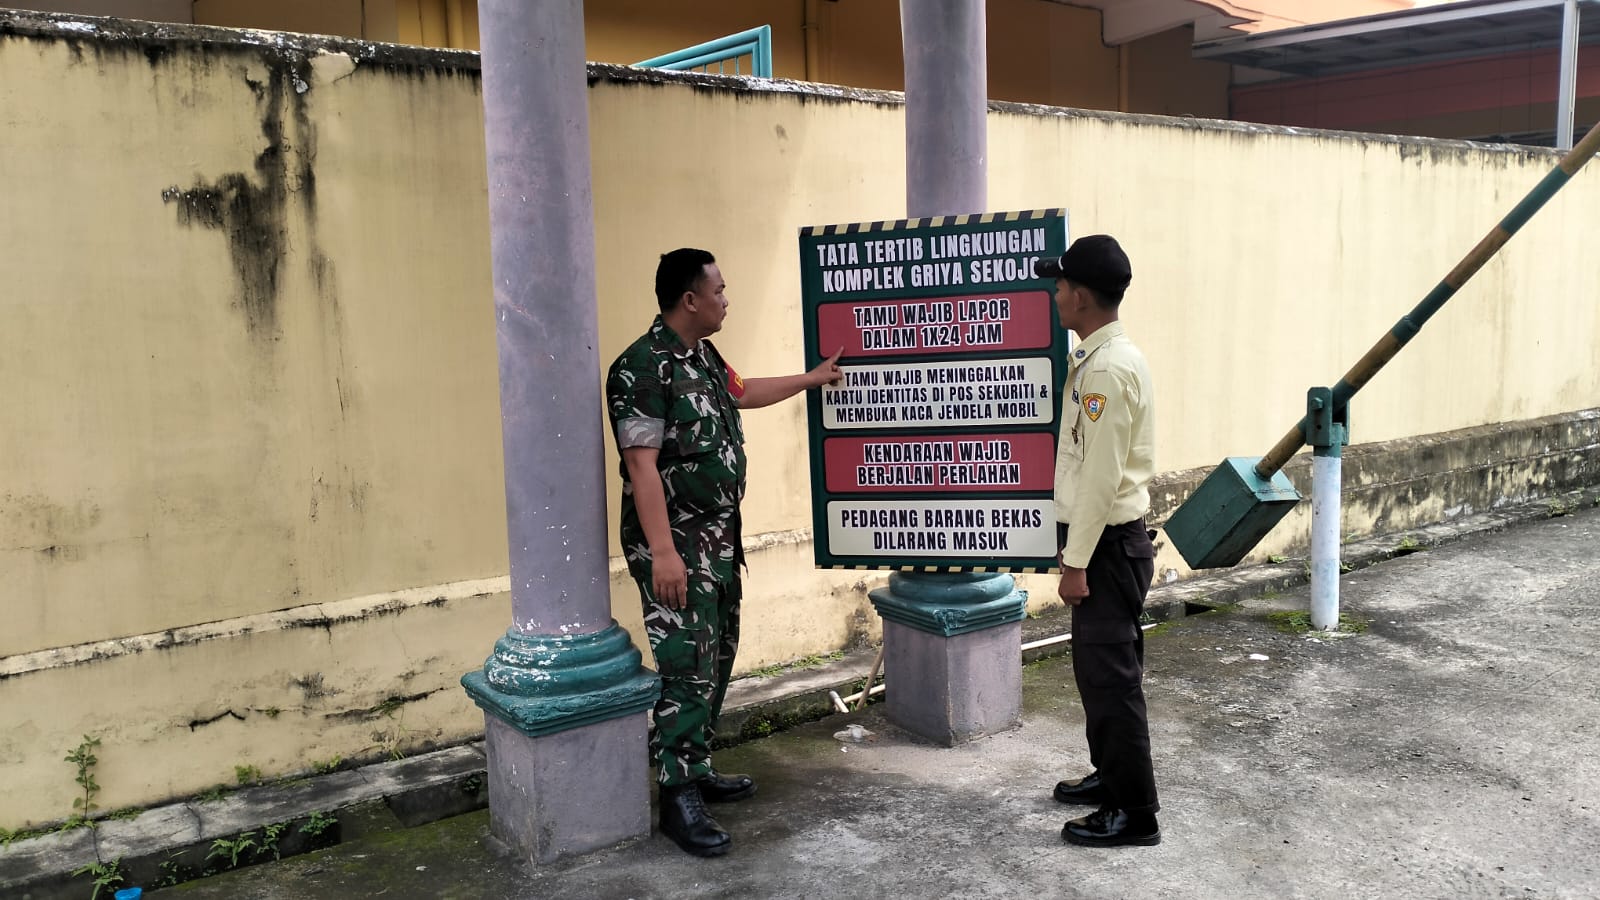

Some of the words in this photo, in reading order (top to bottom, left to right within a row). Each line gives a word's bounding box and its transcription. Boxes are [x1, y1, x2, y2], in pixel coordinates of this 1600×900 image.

[817, 243, 858, 266] TATA
[865, 237, 923, 263] TERTIB
[931, 228, 1045, 258] LINGKUNGAN
[823, 266, 904, 292] KOMPLEK
[911, 262, 963, 287] GRIYA
[855, 305, 897, 327] TAMU
[903, 302, 953, 325] WAJIB
[959, 299, 1010, 321] LAPOR
[863, 328, 915, 350] DALAM
[922, 326, 959, 346] 1X24
[966, 324, 1003, 345] JAM
[846, 370, 878, 386] TAMU
[883, 368, 922, 384] WAJIB
[927, 365, 1024, 383] MENINGGALKAN
[826, 390, 862, 405] KARTU
[868, 387, 927, 404] IDENTITAS
[933, 387, 944, 401] DI
[950, 386, 973, 401] POS
[979, 384, 1034, 400] SEKURITI
[1040, 384, 1048, 398] &
[836, 406, 896, 422] MEMBUKA
[902, 405, 933, 420] KACA
[938, 403, 992, 420] JENDELA
[998, 402, 1038, 418] MOBIL
[864, 442, 953, 464] KENDARAAN
[959, 440, 1010, 462] WAJIB
[857, 465, 933, 486] BERJALAN
[940, 464, 1020, 485] PERLAHAN
[842, 510, 918, 527] PEDAGANG
[925, 509, 985, 527] BARANG
[992, 509, 1041, 527] BEKAS
[874, 532, 946, 550] DILARANG
[953, 532, 1008, 550] MASUK
